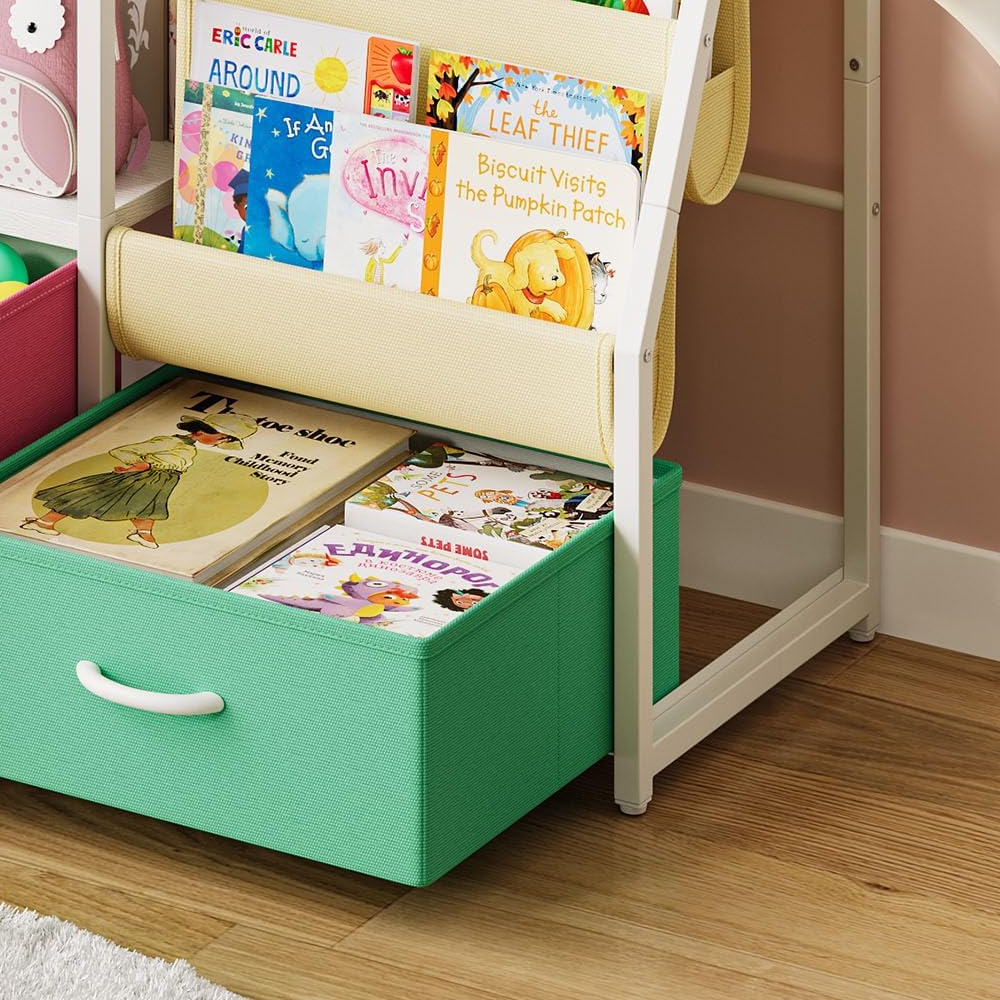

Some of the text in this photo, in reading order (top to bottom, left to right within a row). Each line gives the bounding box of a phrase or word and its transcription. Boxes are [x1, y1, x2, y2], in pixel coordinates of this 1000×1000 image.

[254, 35, 298, 58] CARLE
[208, 58, 302, 99] AROUND
[532, 99, 559, 119] the
[283, 112, 333, 138] If An
[488, 109, 610, 154] LEAF THIEF
[477, 152, 608, 198] Biscuit Visits
[456, 179, 627, 230] the Pumpkin Patch
[294, 427, 357, 449] shoe
[224, 455, 301, 479] Childhood
[250, 452, 311, 473] Memory
[279, 450, 320, 466] Fond
[250, 470, 290, 486] Story
